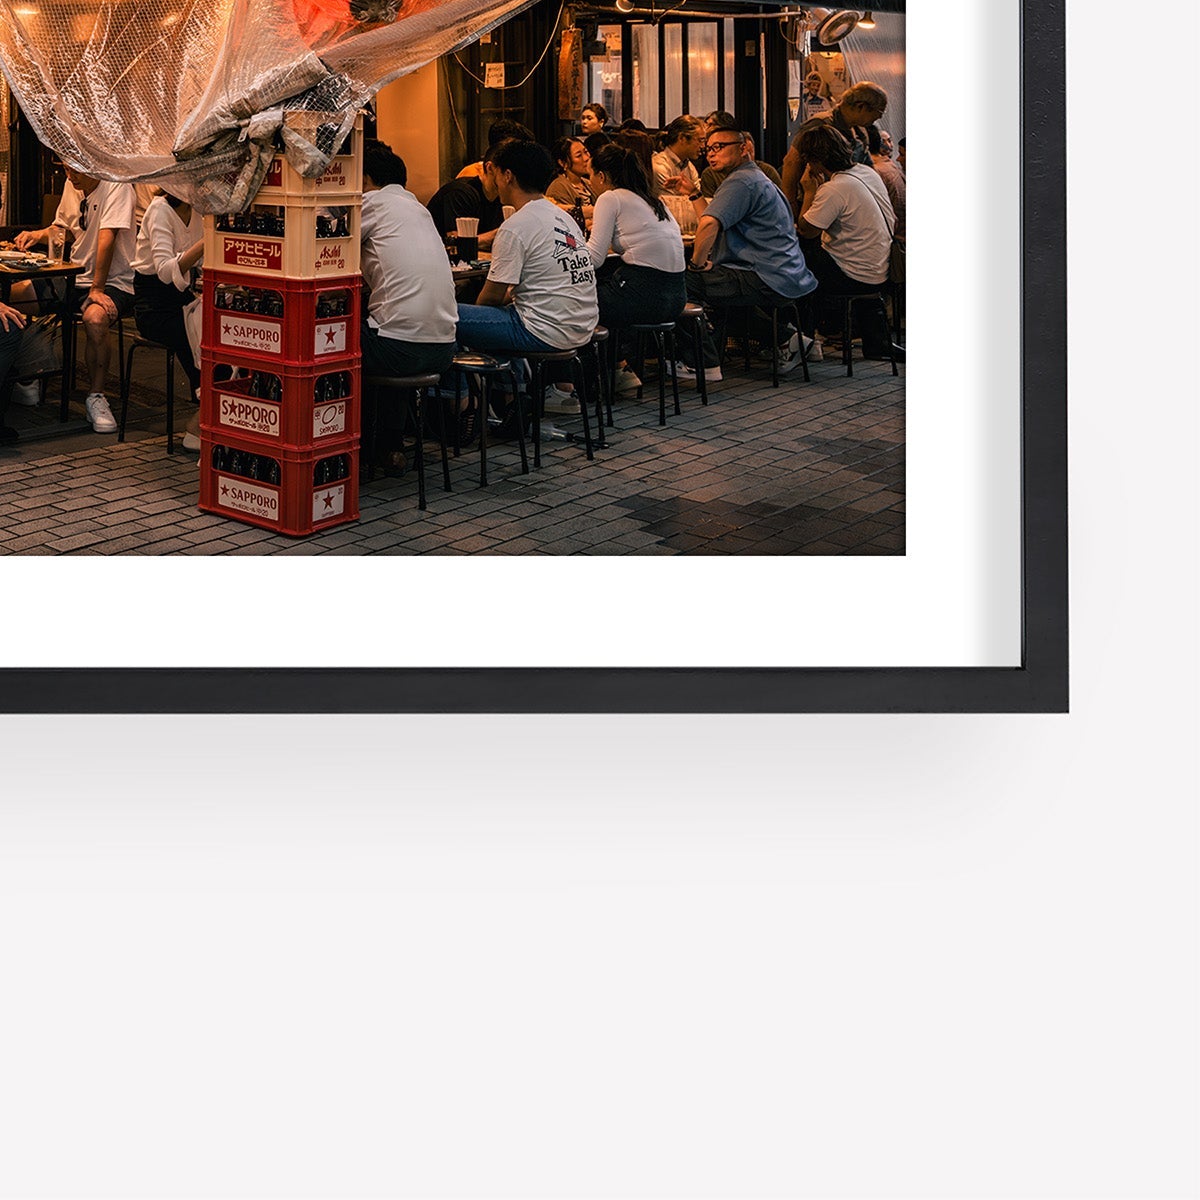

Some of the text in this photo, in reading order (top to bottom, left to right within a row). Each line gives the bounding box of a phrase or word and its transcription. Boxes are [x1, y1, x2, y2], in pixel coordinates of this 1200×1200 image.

[225, 240, 281, 257] アサヒビール
[557, 254, 589, 272] Take
[570, 270, 594, 285] Easy
[233, 325, 280, 343] SAPPORO
[231, 488, 277, 510] SAPPORO
